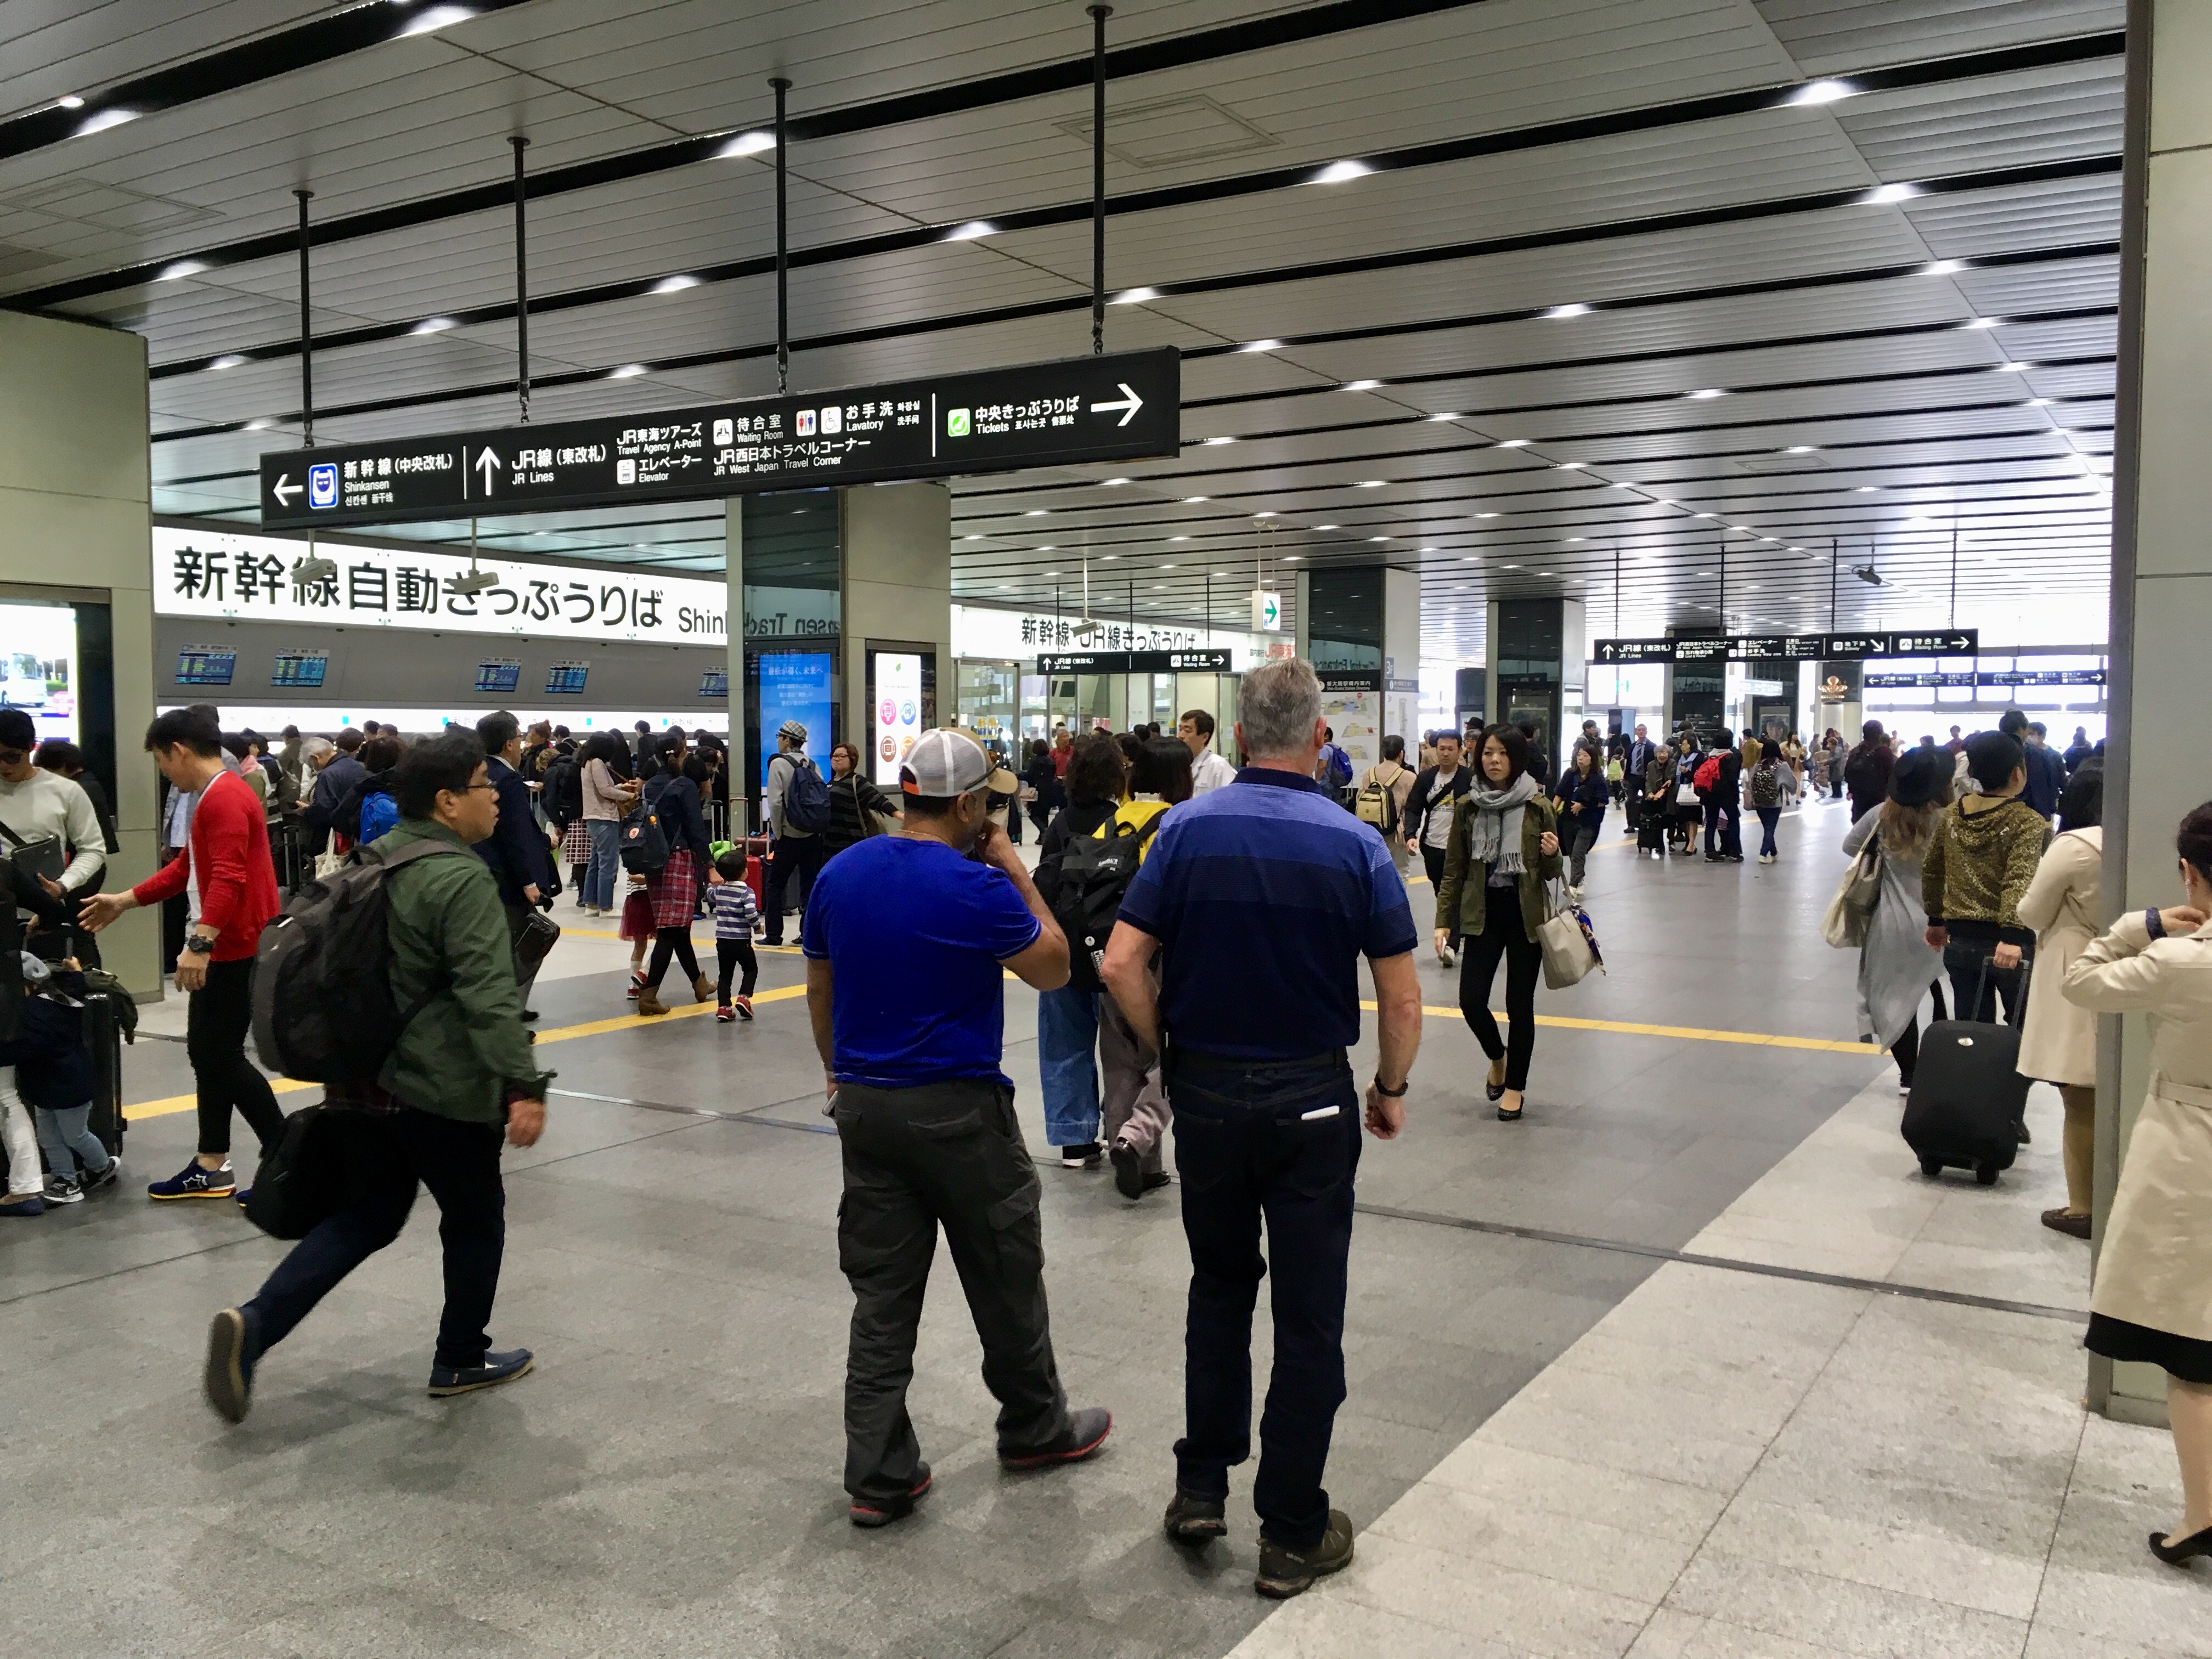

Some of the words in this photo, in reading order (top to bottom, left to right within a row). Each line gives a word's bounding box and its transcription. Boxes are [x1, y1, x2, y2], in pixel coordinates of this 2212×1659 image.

[846, 401, 894, 420] お手洗
[897, 400, 921, 413] 화장실
[975, 395, 1080, 422] 中央きっぷうりば
[737, 414, 782, 432] 待合室
[847, 420, 884, 432] Lavatory
[897, 414, 919, 426] 洗手间
[1015, 418, 1046, 431] 표사는곳
[617, 422, 702, 445] JR東海ツアーズ
[975, 421, 1009, 435] Tickets
[737, 432, 761, 443] Waiting
[764, 430, 783, 441] Room
[617, 444, 641, 456] Travel
[643, 441, 672, 455] Agency
[674, 438, 702, 450] A-Point
[714, 438, 871, 465] JR西日本トラベルコーナー
[639, 455, 703, 471] エレベーター
[714, 464, 726, 476] JR
[730, 462, 750, 474] West
[754, 461, 779, 474] Japan
[785, 458, 809, 470] Travel
[813, 455, 842, 467] Corner
[512, 473, 525, 486] JR
[530, 471, 554, 483] Lines
[639, 471, 669, 483] Elevator
[344, 479, 390, 493] Shinkansen
[345, 495, 367, 506] 신칸센
[371, 492, 393, 504] 新干线
[678, 606, 728, 633] Shin
